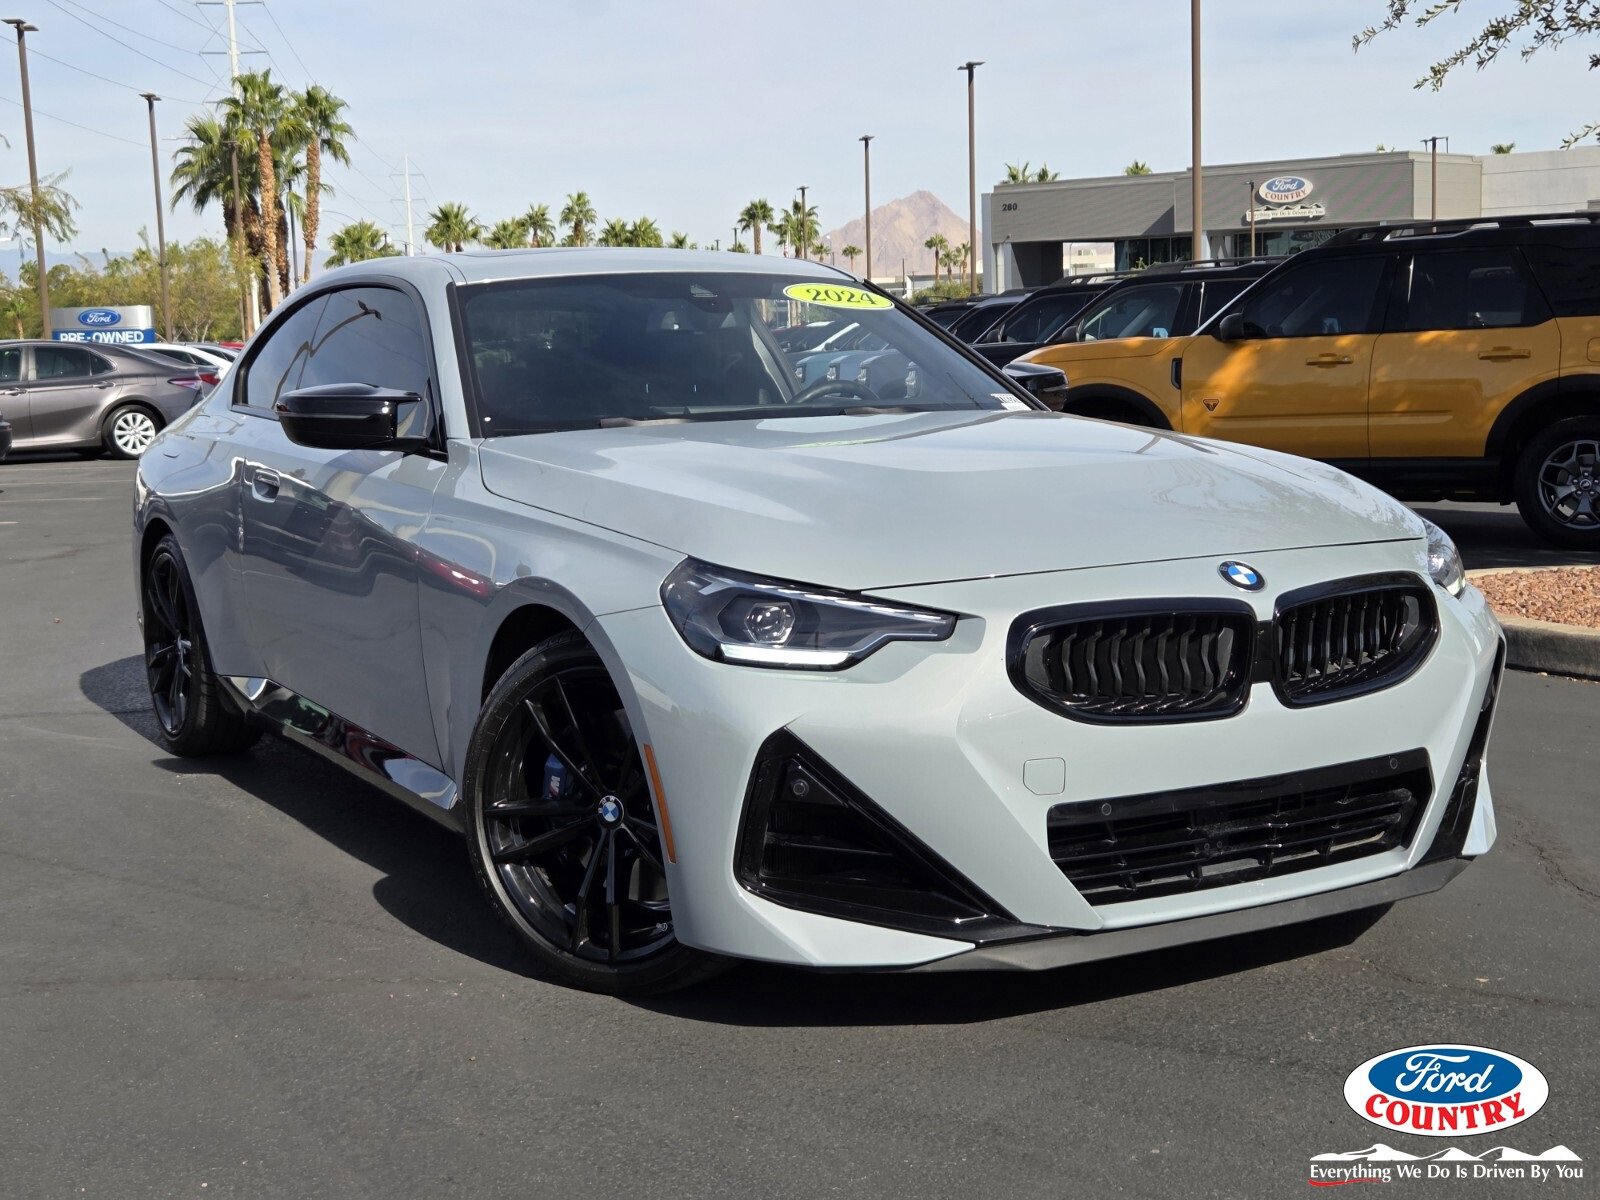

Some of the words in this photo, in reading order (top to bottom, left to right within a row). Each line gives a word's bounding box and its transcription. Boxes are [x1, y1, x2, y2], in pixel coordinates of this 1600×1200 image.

[1272, 178, 1299, 191] Ford
[1265, 189, 1307, 200] COUNTRY
[1002, 202, 1017, 211] 280
[806, 288, 877, 305] 2024
[87, 312, 112, 323] Ford
[60, 331, 144, 343] PRE-OWNED
